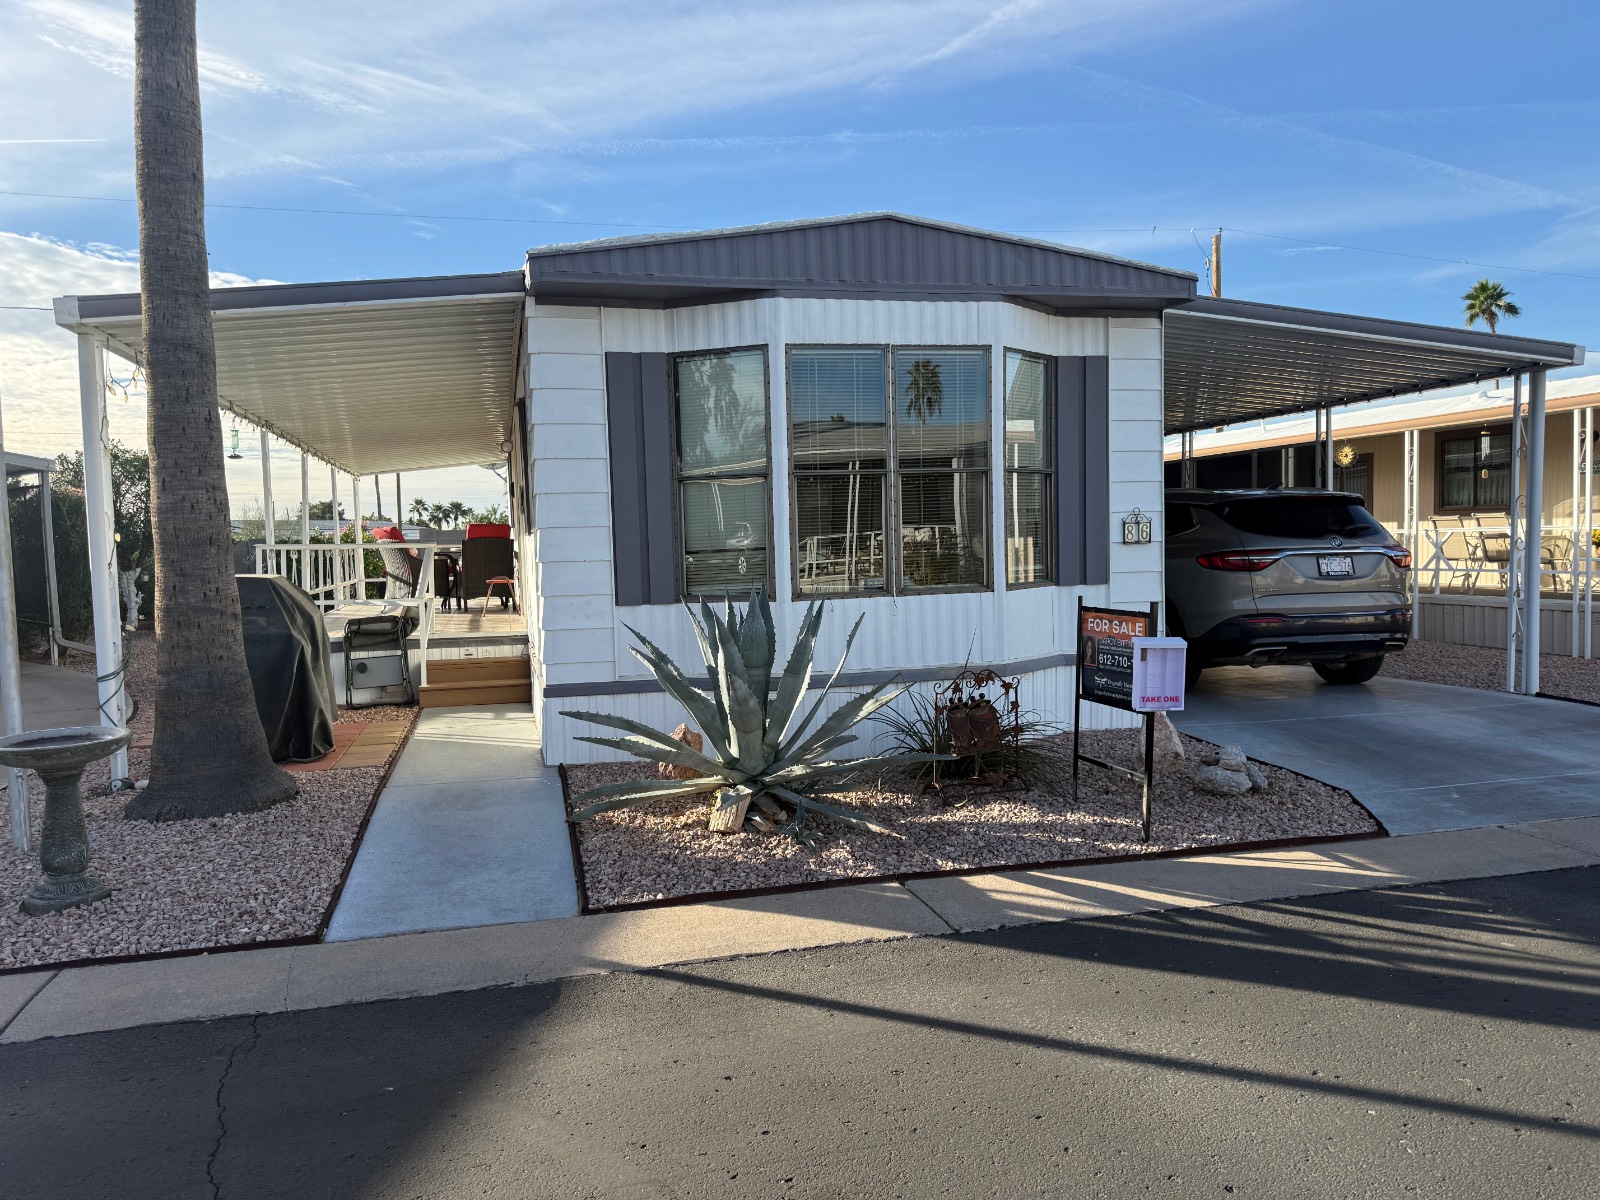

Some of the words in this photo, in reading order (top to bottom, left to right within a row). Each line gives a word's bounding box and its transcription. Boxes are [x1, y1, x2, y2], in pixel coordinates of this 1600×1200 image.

[1126, 523, 1149, 541] 86
[1087, 618, 1109, 633] FOR
[1112, 620, 1143, 636] SALE
